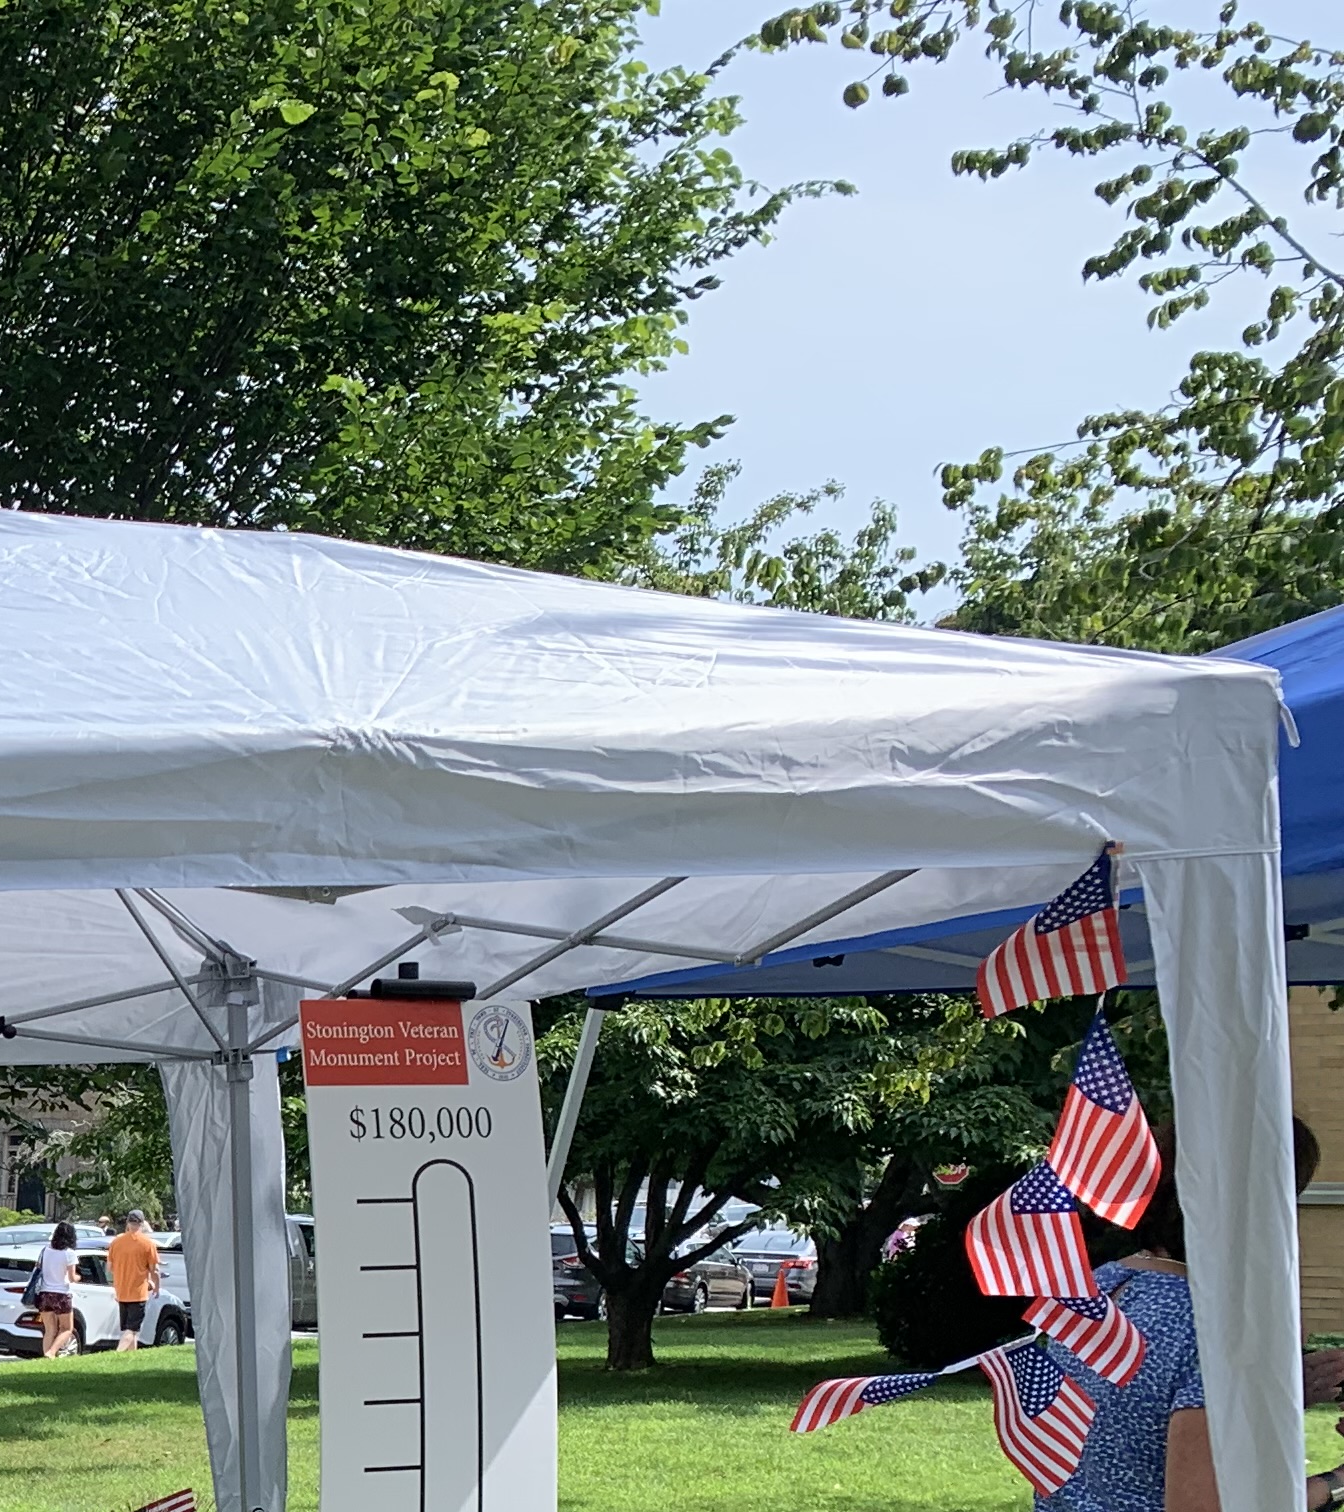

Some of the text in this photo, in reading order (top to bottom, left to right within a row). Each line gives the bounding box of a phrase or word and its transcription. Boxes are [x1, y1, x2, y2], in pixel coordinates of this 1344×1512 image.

[306, 1021, 459, 1043] Stonington Veteran
[309, 1048, 461, 1071] Monument Project
[349, 1105, 492, 1144] $180,000
